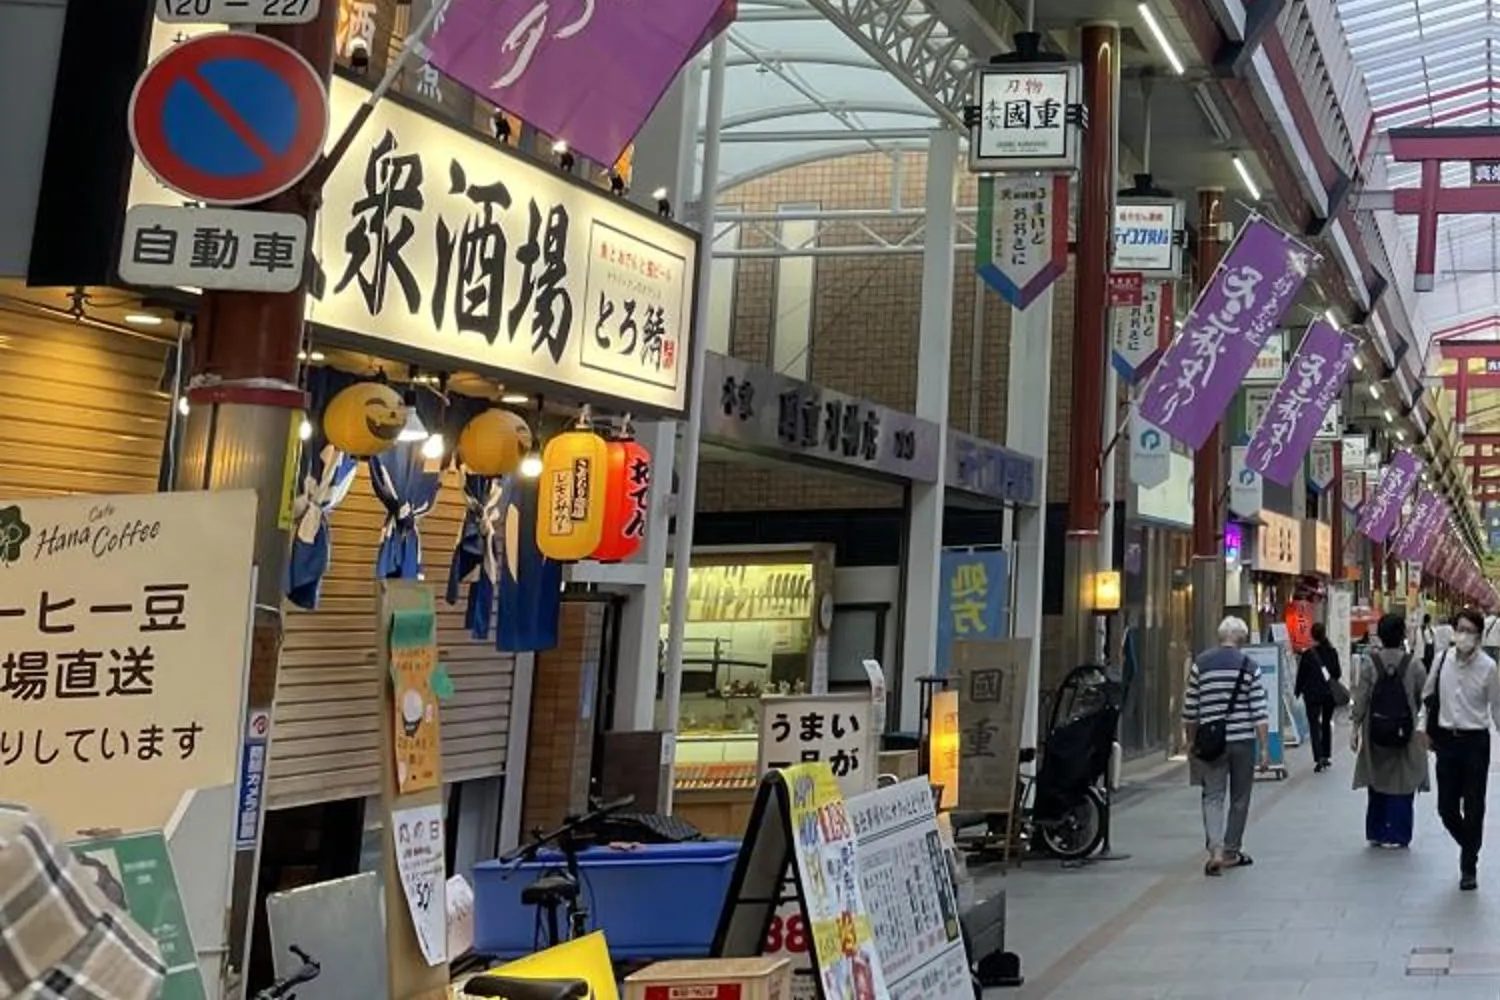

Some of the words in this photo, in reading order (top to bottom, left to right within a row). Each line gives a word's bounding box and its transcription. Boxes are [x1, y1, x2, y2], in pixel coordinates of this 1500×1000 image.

[310, 130, 578, 364] 衆酒場
[1011, 207, 1028, 266] おおきに
[1030, 202, 1047, 246] まいど
[133, 224, 296, 273] 自動車
[624, 458, 649, 537] おでん
[34, 524, 91, 560] Hana
[91, 519, 161, 558] Coffee
[0, 719, 203, 767] りしています
[771, 711, 861, 743] うまい
